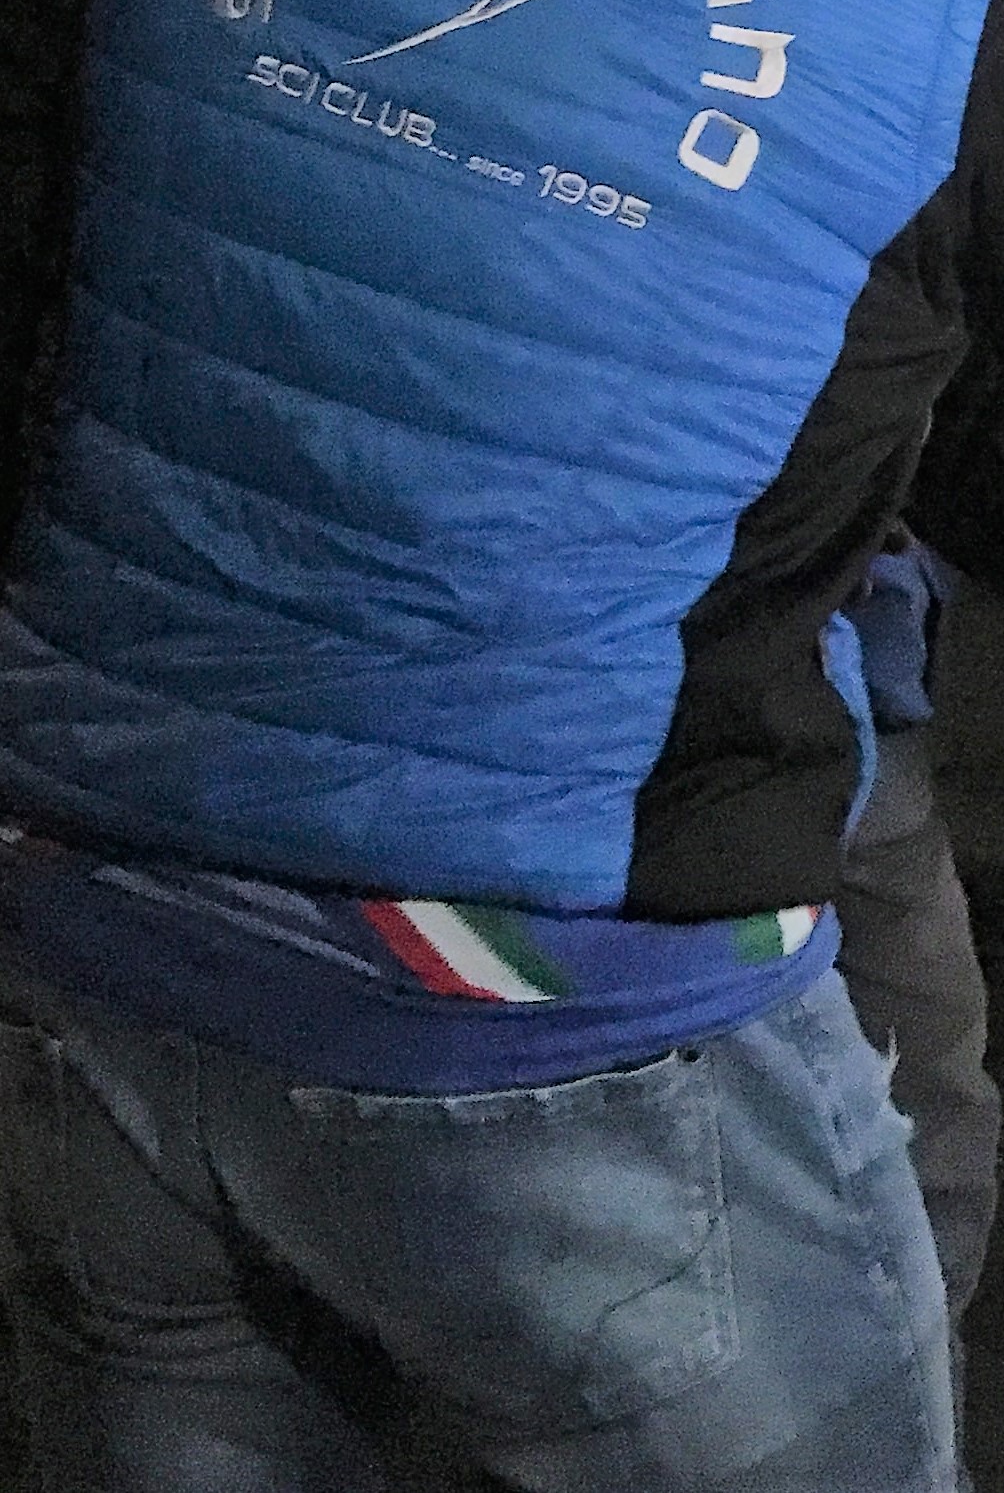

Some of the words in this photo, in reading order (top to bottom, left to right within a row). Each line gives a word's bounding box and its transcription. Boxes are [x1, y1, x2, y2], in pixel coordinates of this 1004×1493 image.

[247, 55, 320, 105] SCI
[464, 154, 526, 187] since
[537, 163, 652, 230] 1995
